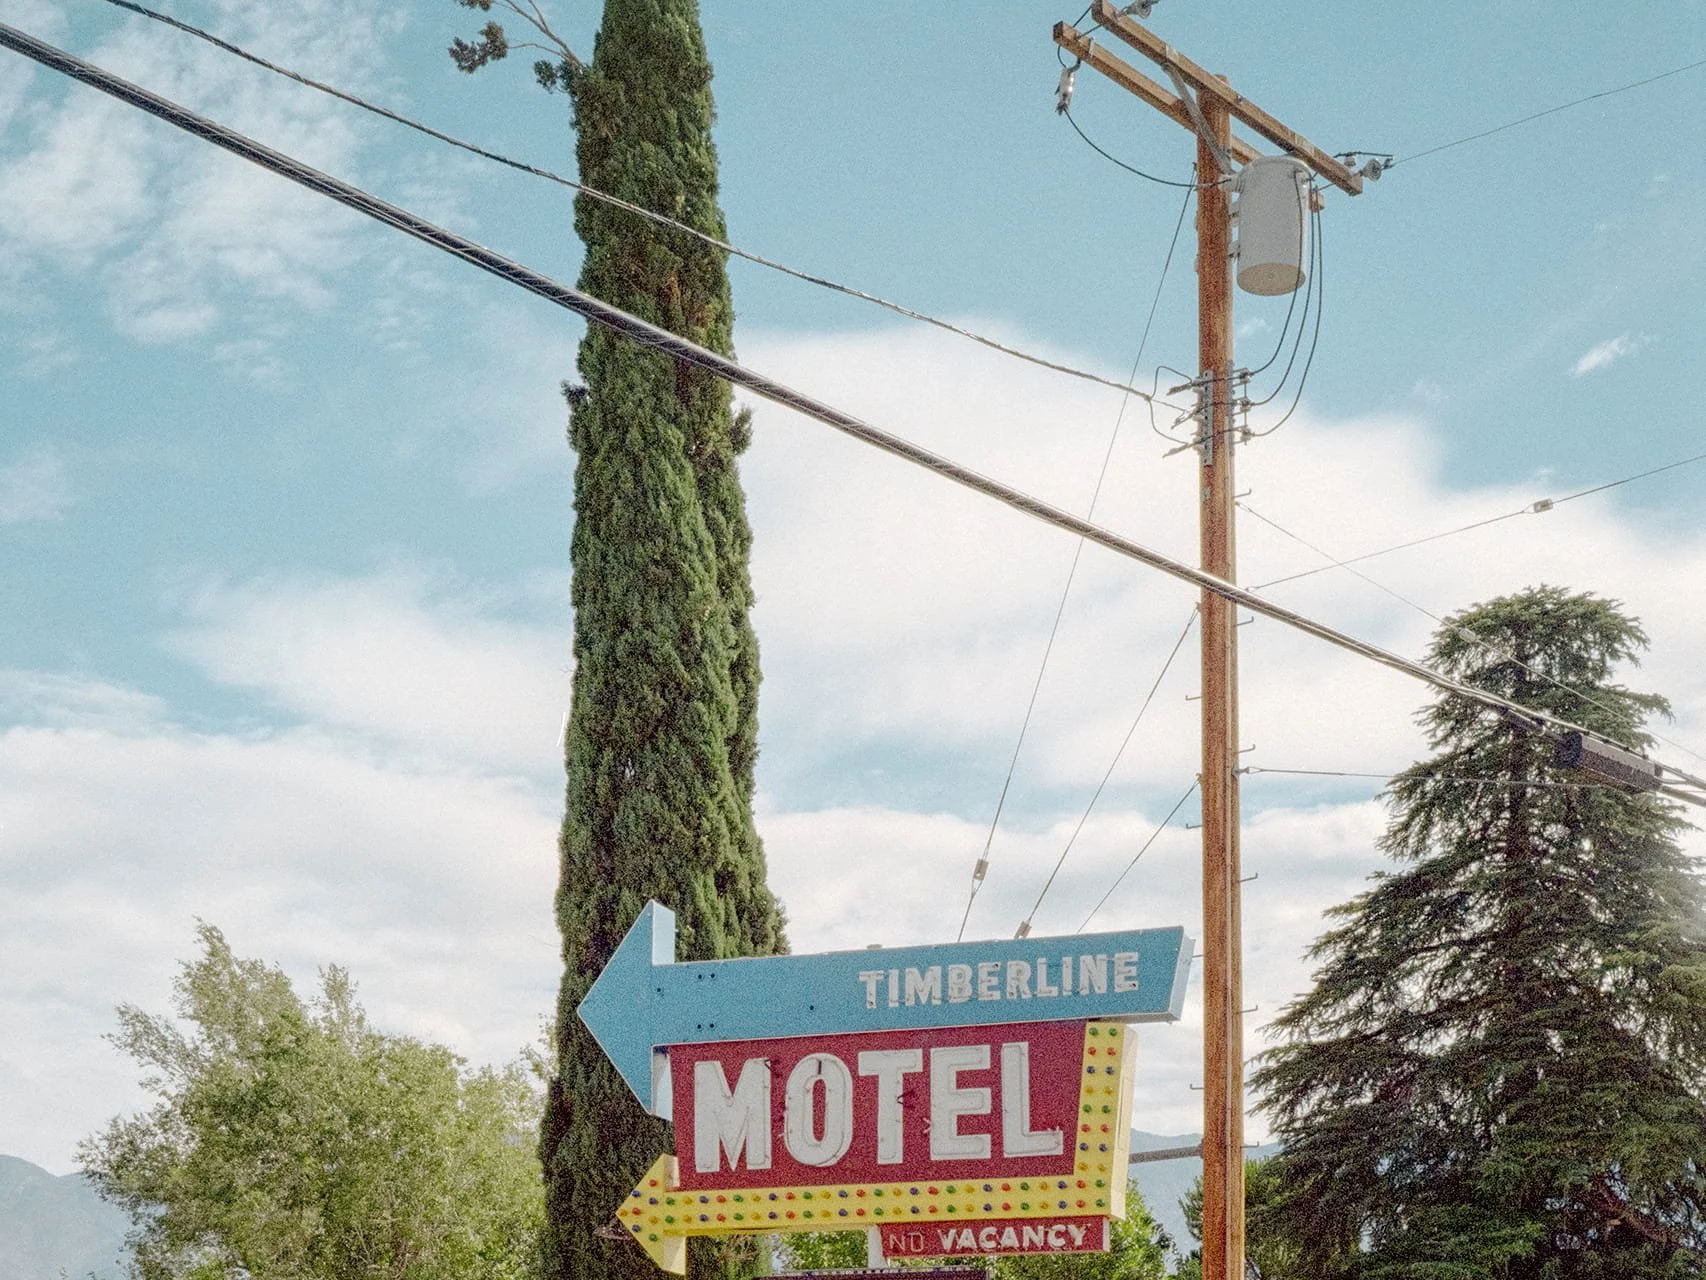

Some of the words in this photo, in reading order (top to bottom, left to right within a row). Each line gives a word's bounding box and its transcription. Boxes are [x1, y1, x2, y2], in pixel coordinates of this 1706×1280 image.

[858, 952, 1140, 1009] TIMBERLINE
[694, 1041, 1064, 1173] MOTEL
[889, 1231, 925, 1252] NO
[937, 1223, 1089, 1250] VACANCY
